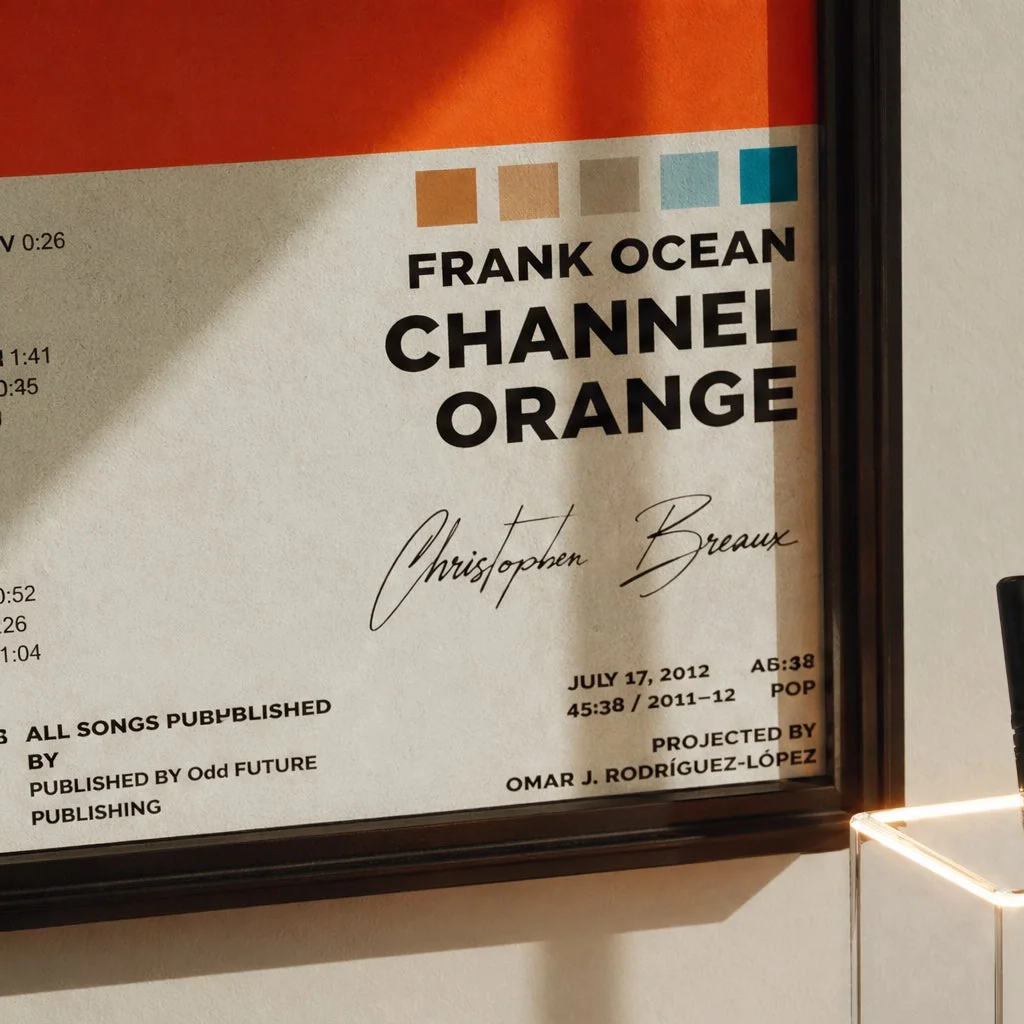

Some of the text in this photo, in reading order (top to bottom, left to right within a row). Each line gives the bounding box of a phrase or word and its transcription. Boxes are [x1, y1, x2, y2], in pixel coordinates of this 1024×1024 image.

[23, 232, 65, 251] 0:26
[409, 227, 795, 289] FRANK OCEAN
[385, 289, 797, 372] CHANNEL
[11, 347, 49, 365] 1:41
[436, 365, 797, 448] ORANGE
[620, 494, 798, 598] Breaux
[568, 665, 709, 690] JULY 17, 2012
[772, 680, 816, 697] POP
[567, 697, 624, 717] 45:38
[26, 724, 70, 742] ALL
[77, 715, 159, 737] SONGS
[652, 723, 816, 752] PROJECTED BY
[28, 752, 58, 770] BY
[506, 749, 817, 792] OMAR J. RODRÍGUEZ-LÓPEZ
[30, 756, 317, 797] PUBLISHED BY Odd FUTURE
[31, 799, 162, 825] PUBLISHING
